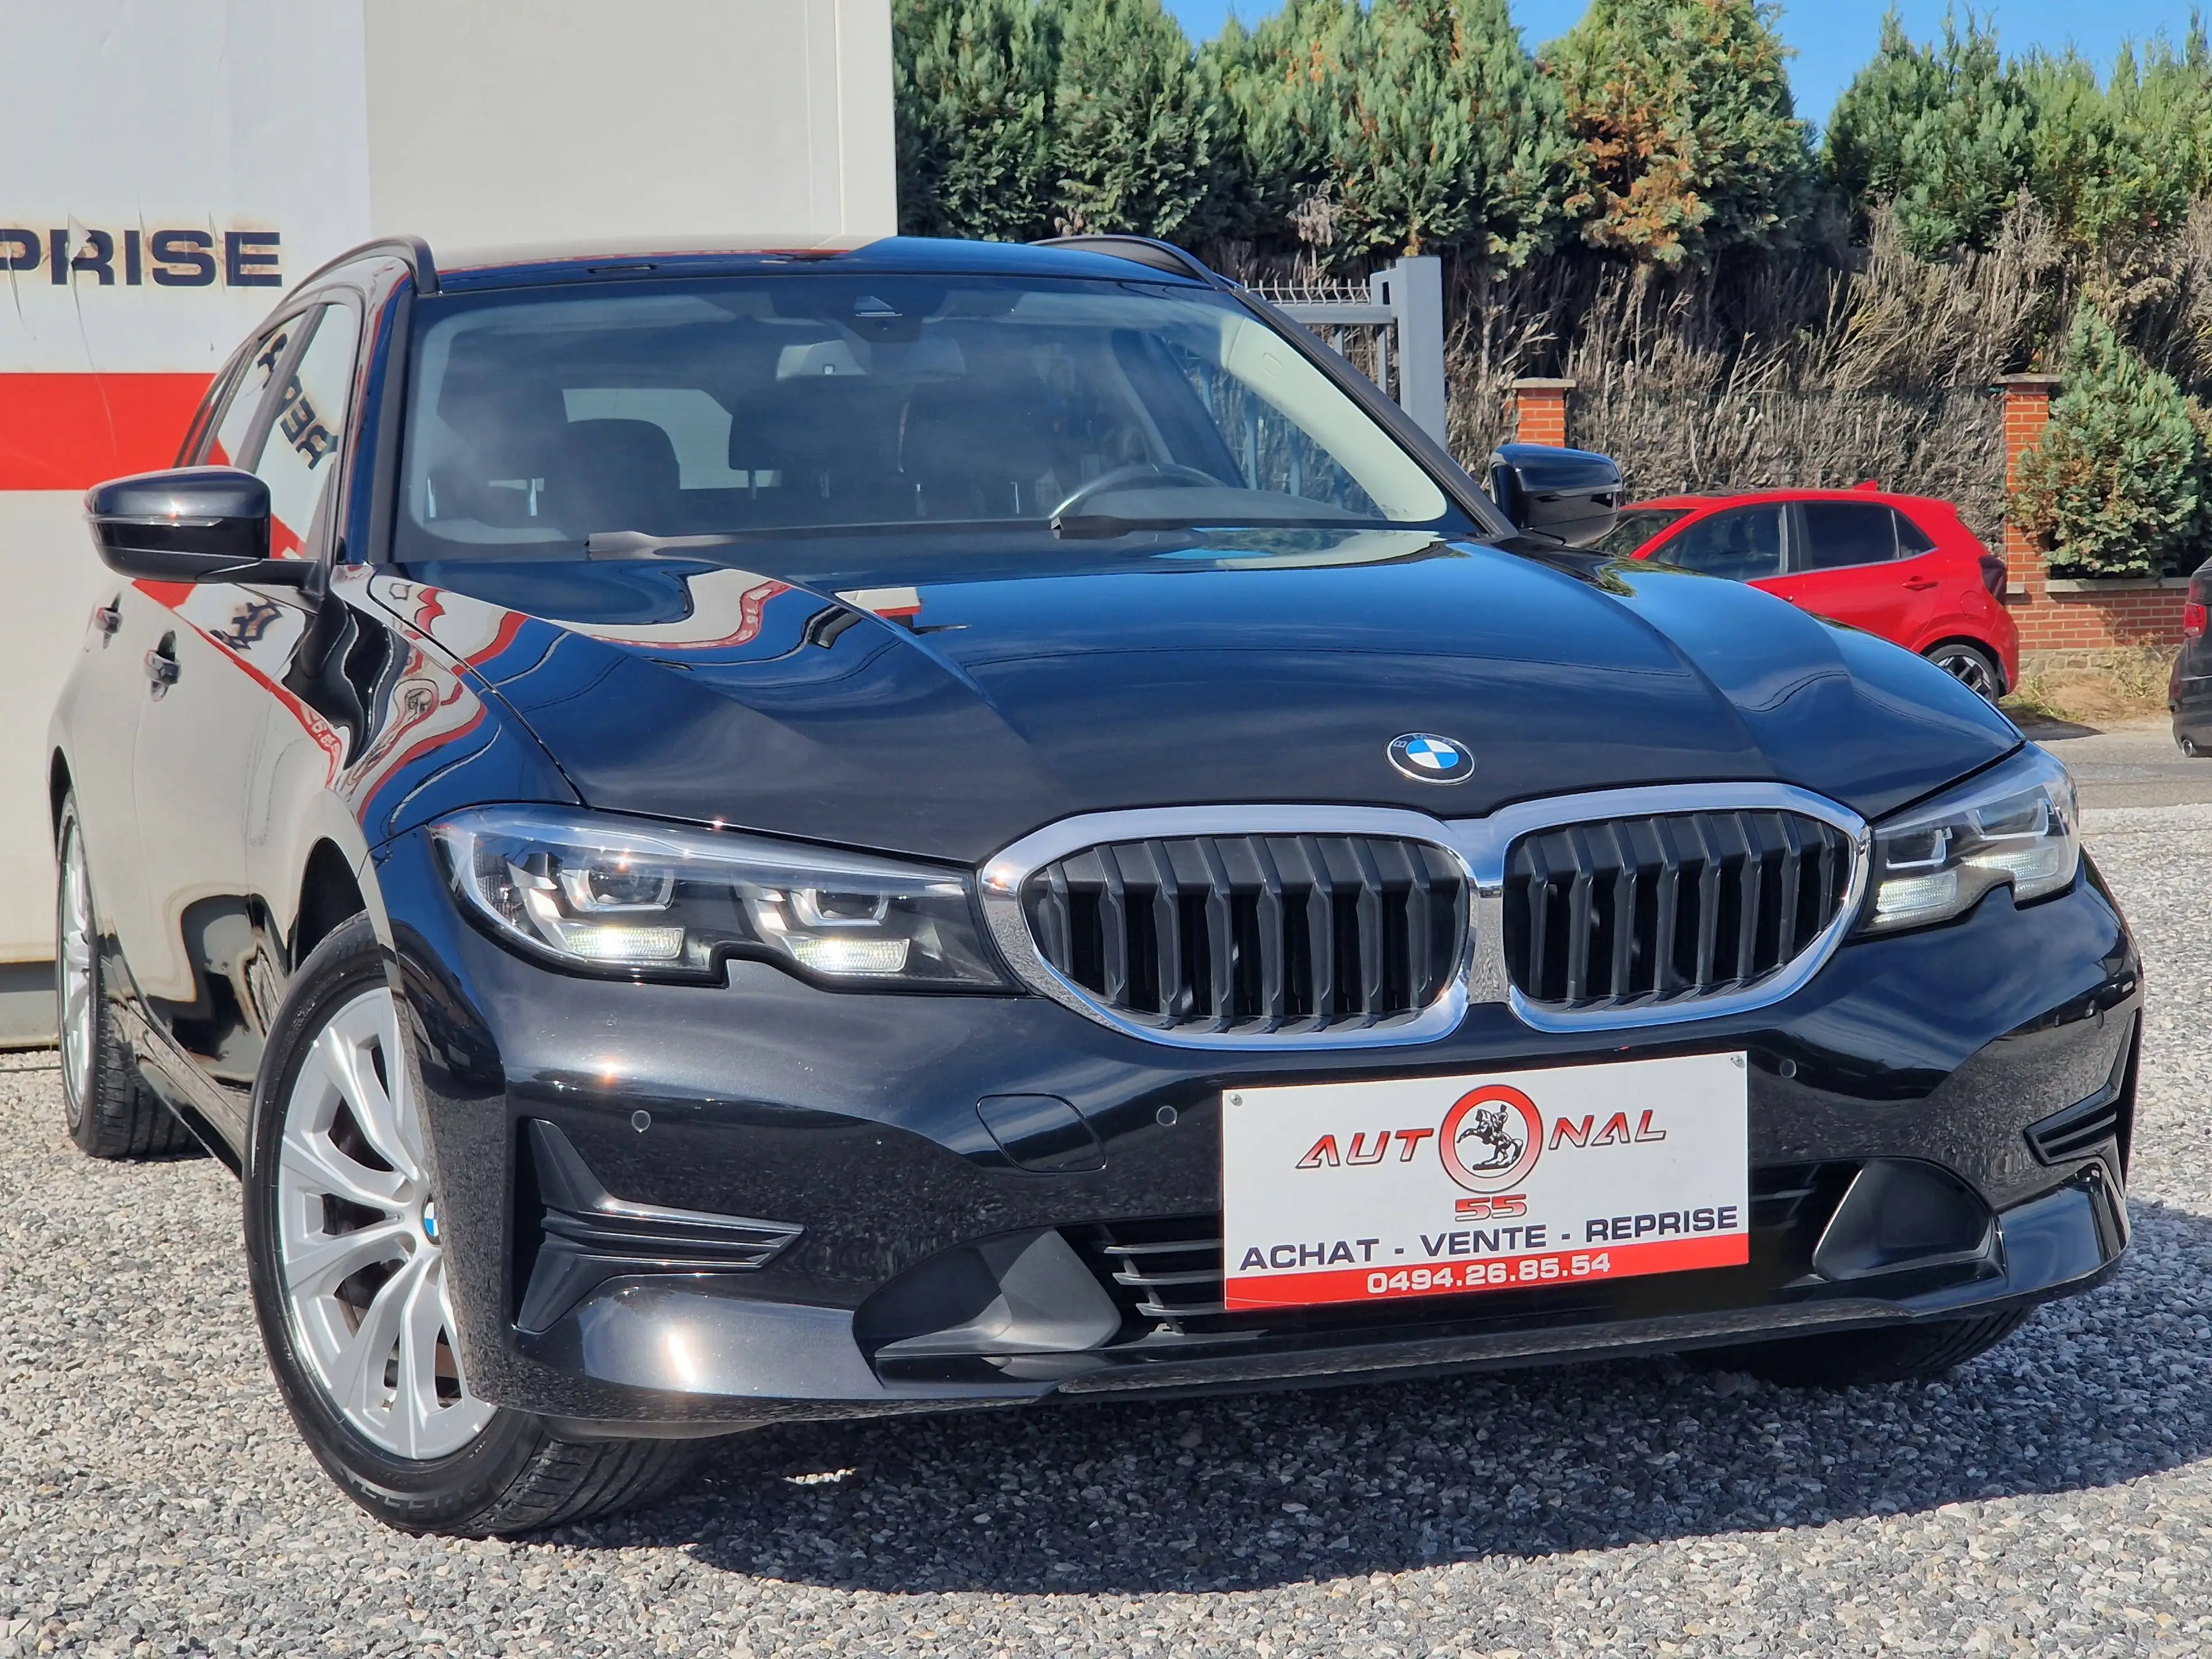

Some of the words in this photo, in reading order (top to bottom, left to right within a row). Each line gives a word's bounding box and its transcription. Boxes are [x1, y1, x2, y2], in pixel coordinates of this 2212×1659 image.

[0, 229, 282, 287] PRISE
[1392, 734, 1459, 748] BMW
[1455, 1194, 1528, 1222] 55
[1239, 1238, 1380, 1271] ACHAT
[1419, 1224, 1547, 1257] VENTE
[1586, 1206, 1737, 1243] REPRISE
[1366, 1252, 1611, 1294] 0494.26.85.54
